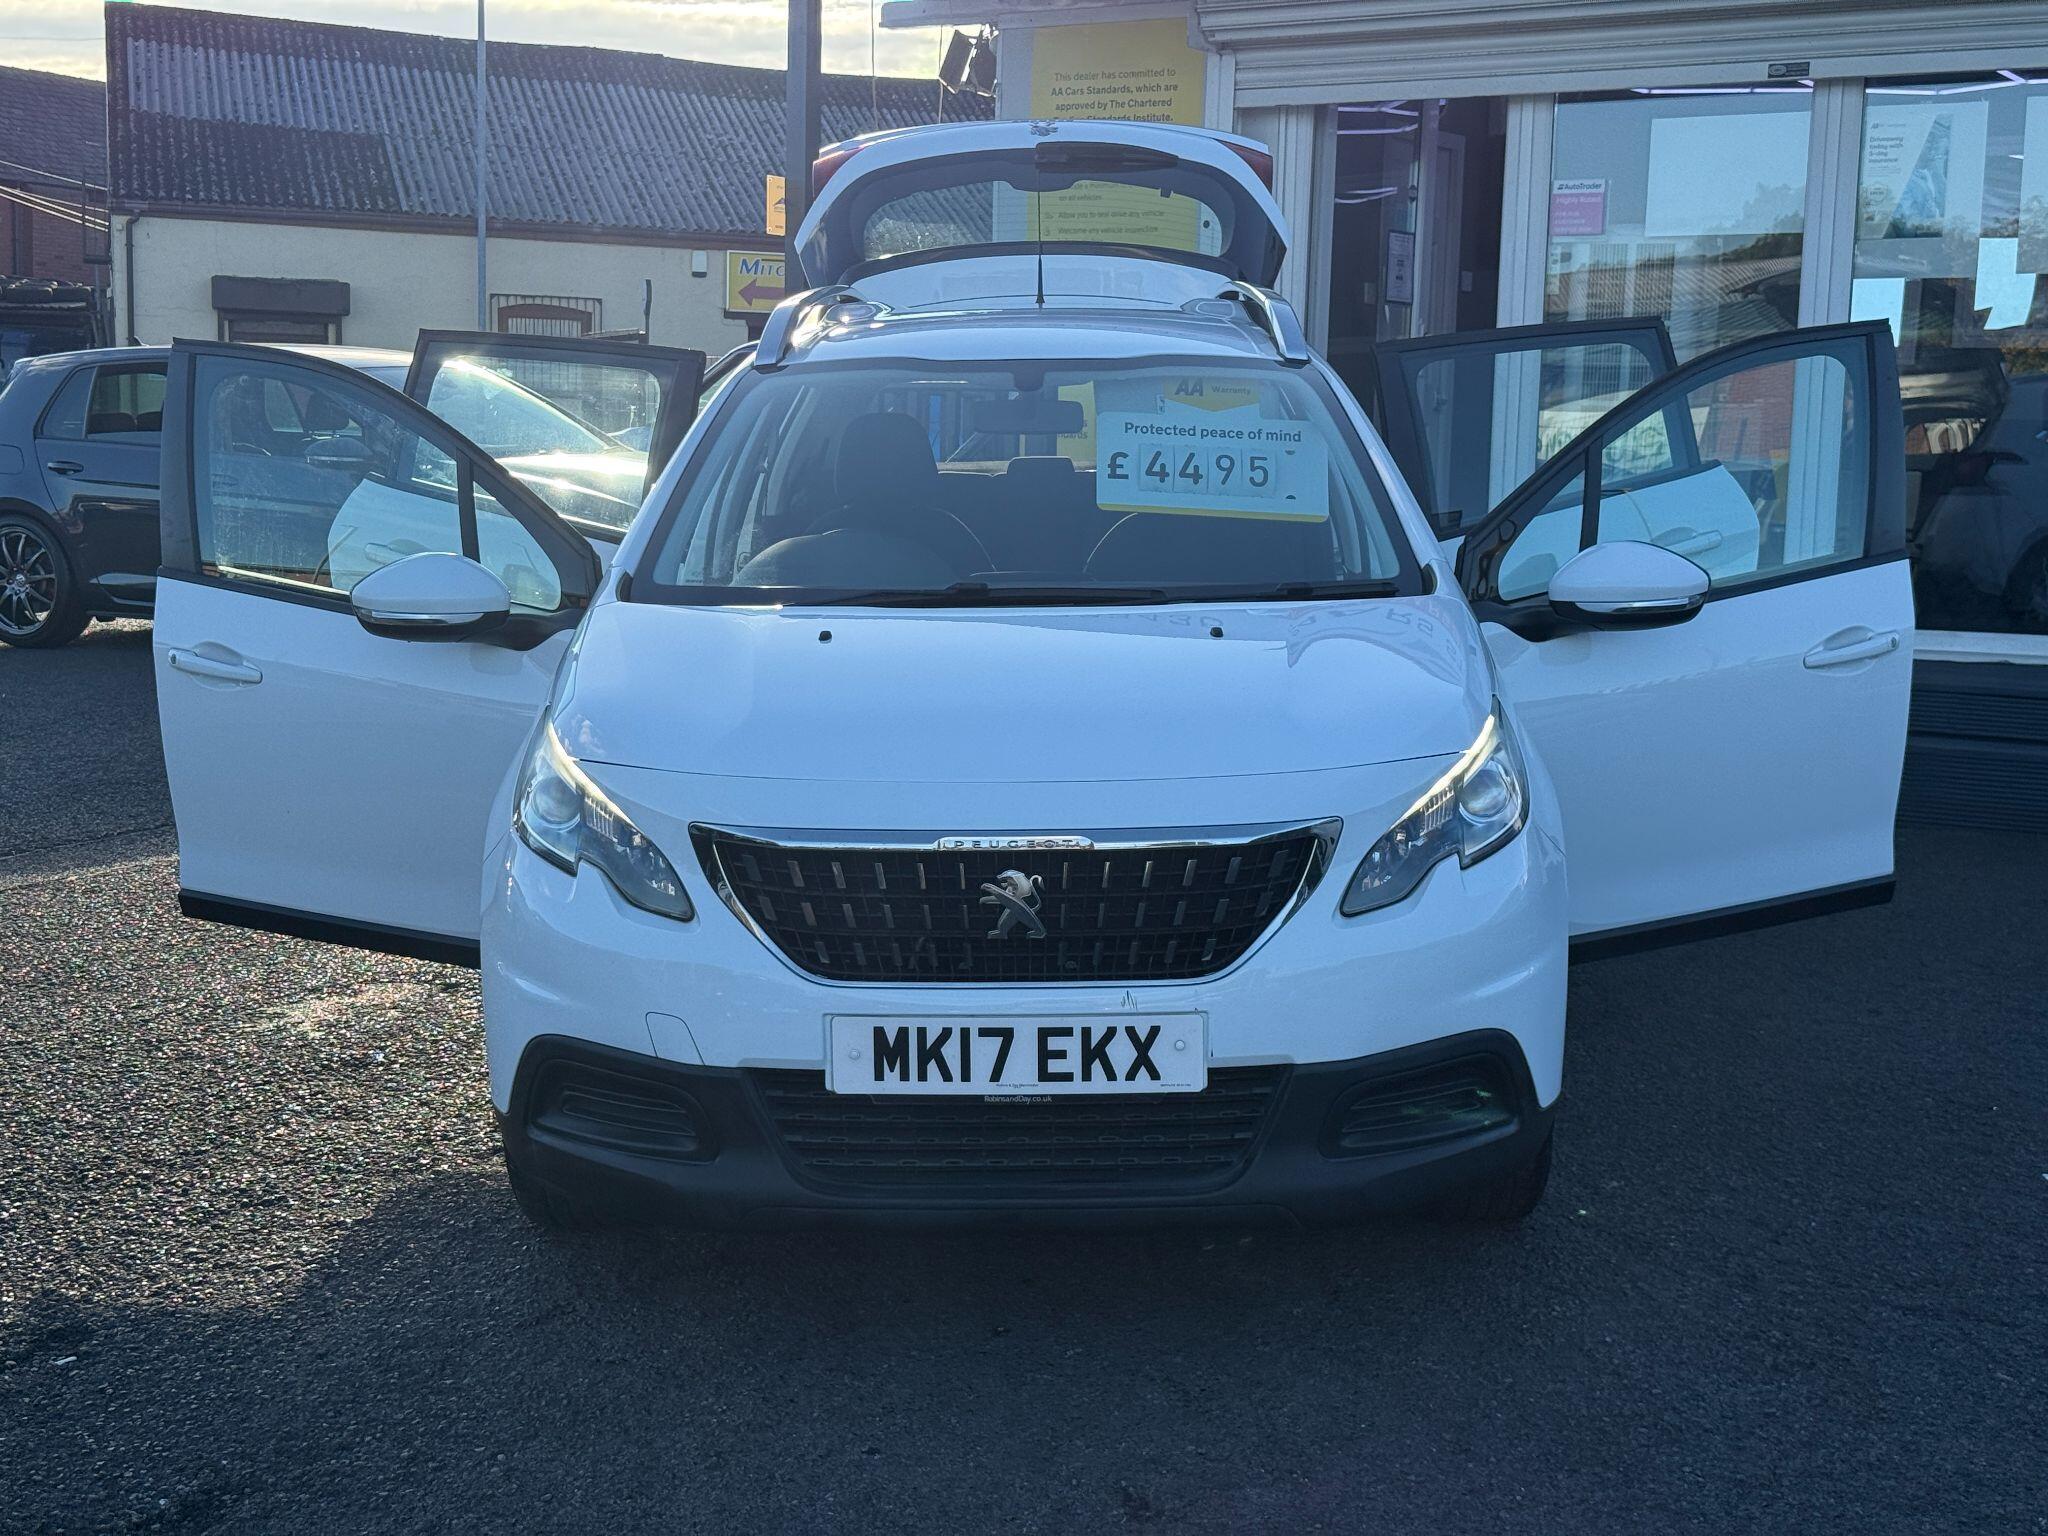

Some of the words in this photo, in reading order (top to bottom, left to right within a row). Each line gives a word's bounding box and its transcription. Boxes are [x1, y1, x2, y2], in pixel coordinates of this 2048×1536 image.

[1055, 72, 1072, 82] This
[1073, 71, 1099, 81] dealer
[1101, 70, 1117, 80] has
[1118, 68, 1165, 79] committed
[1167, 68, 1177, 77] to
[1050, 87, 1064, 97] AA
[1065, 86, 1085, 96] Cars
[1086, 84, 1134, 95] Standards,
[1135, 83, 1162, 93] which
[1163, 83, 1178, 92] are
[1055, 100, 1096, 112] approved
[1097, 100, 1108, 110] by
[1109, 99, 1126, 109] The
[1127, 98, 1173, 108] Chartered
[1174, 377, 1204, 397] AA
[1211, 385, 1251, 396] Warranty
[1124, 422, 1197, 438] Protected
[1200, 428, 1244, 441] peace
[1247, 427, 1262, 441] of
[1265, 429, 1302, 443] mind
[953, 839, 1075, 849] PEUGEOT
[872, 1025, 1015, 1083] MK17
[1037, 1025, 1162, 1083] EKX
[984, 1095, 1053, 1104] RobinsandDay.co.uk
